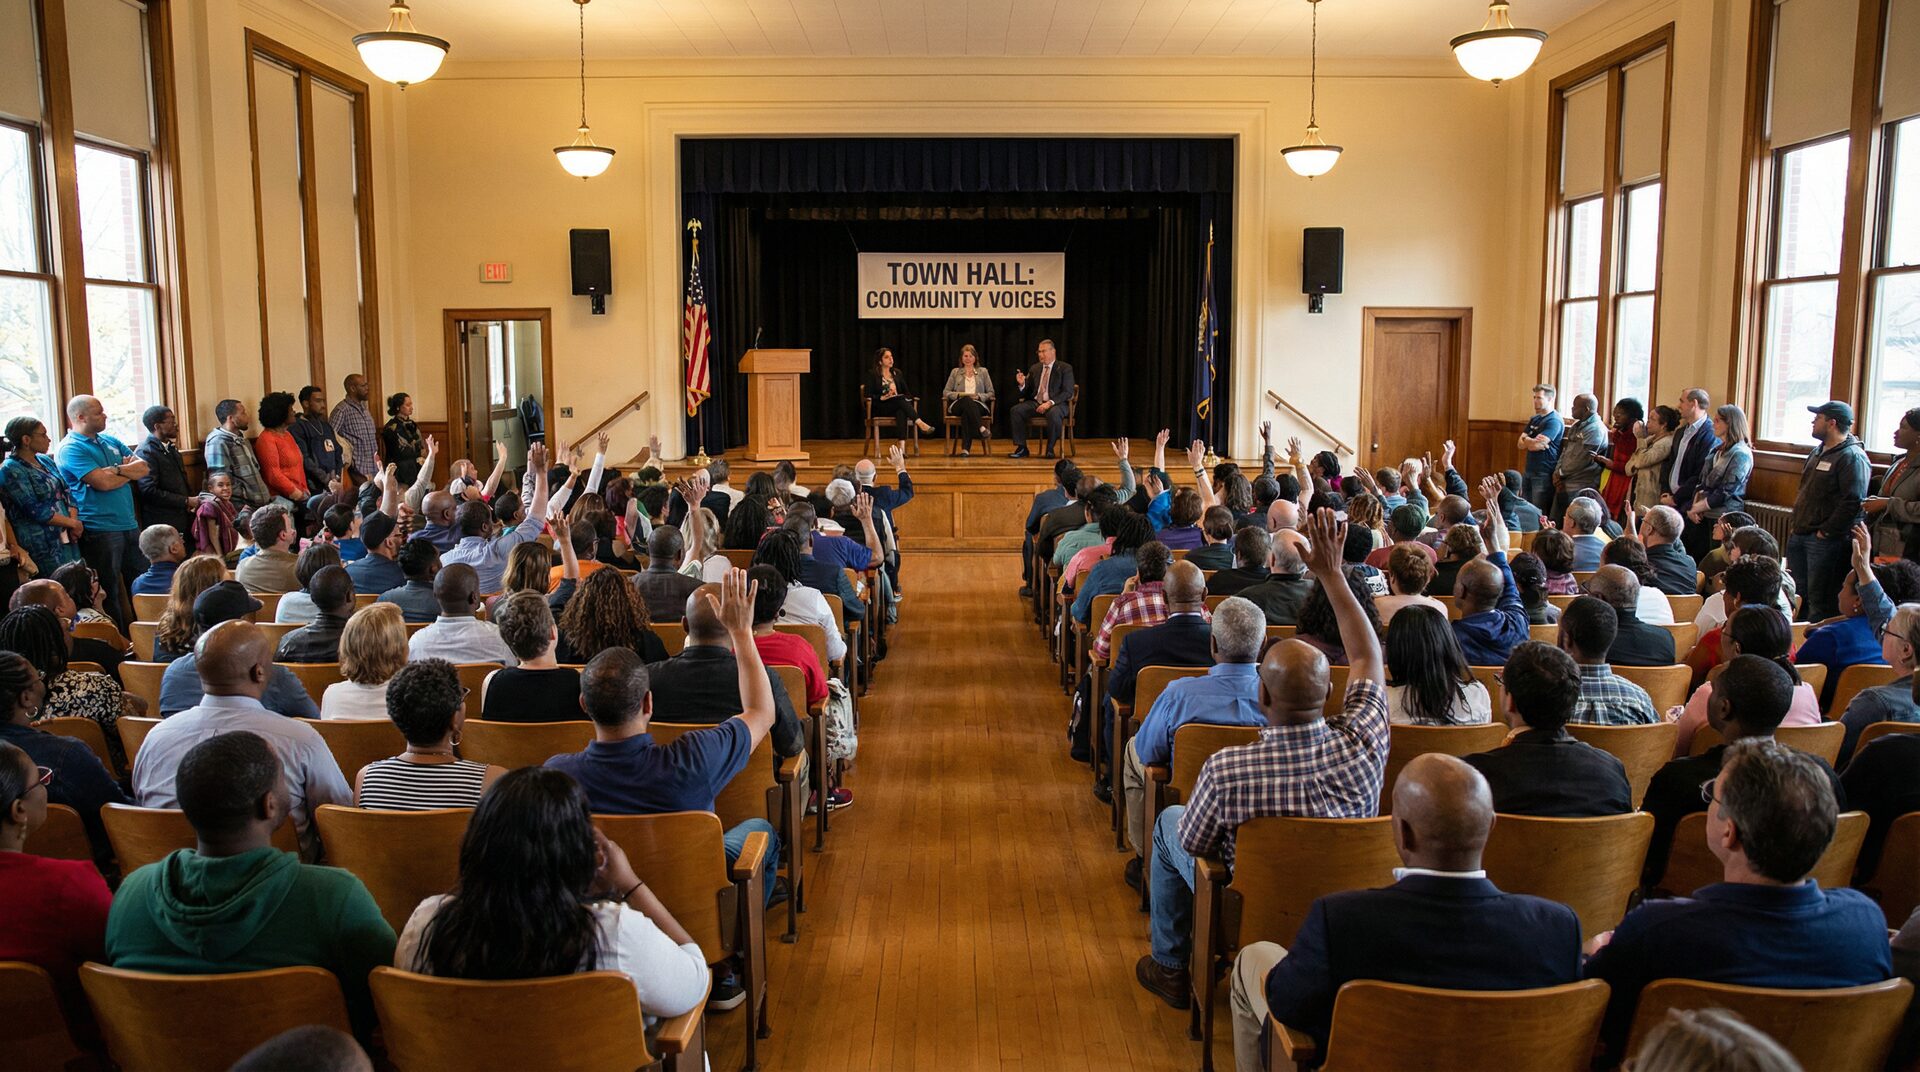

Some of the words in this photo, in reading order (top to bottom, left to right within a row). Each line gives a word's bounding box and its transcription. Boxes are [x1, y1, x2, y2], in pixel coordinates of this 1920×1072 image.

[486, 263, 507, 280] EXIT
[887, 262, 958, 286] TOWN
[967, 262, 1034, 286] HALL:
[866, 290, 983, 309] COMMUNITY
[988, 290, 1056, 309] VOICES
